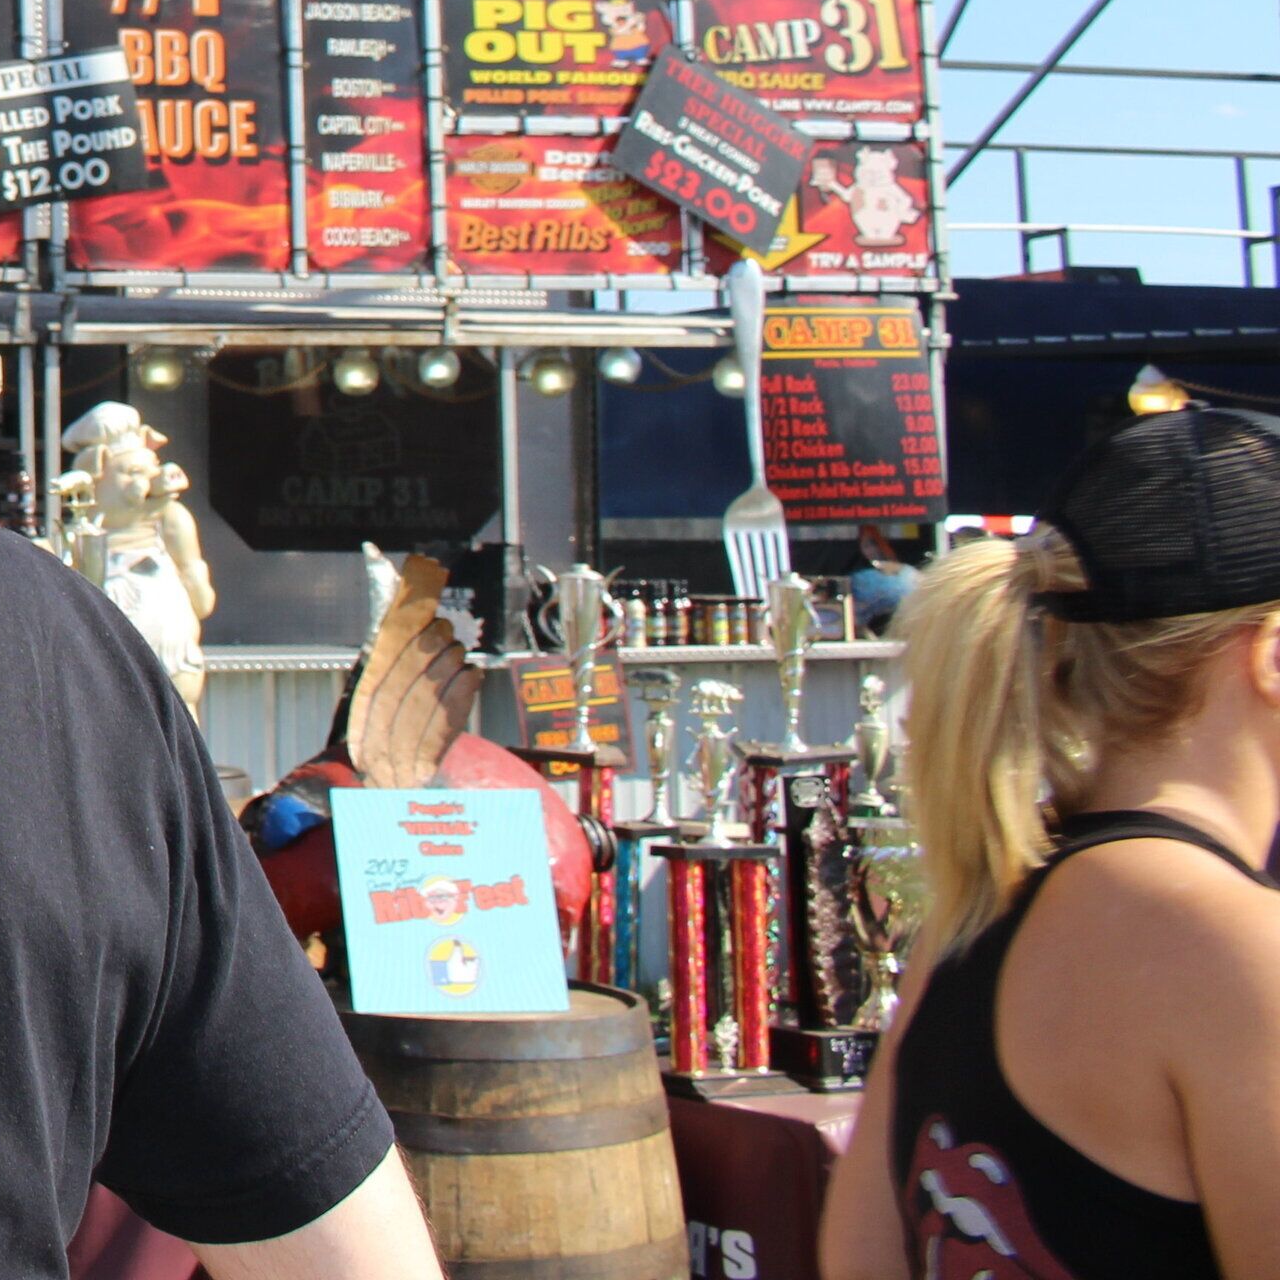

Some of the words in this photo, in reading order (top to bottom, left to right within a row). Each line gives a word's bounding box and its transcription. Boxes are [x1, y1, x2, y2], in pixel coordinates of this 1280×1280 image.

[464, 30, 606, 64] OUT
[703, 18, 822, 66] CAMP
[118, 28, 227, 93] BBQ
[470, 70, 552, 85] WORLD
[760, 72, 826, 92] SAUCE
[135, 99, 258, 158] AUCE
[683, 96, 768, 162] SPECIAL
[2, 157, 111, 203] $12.00
[322, 152, 397, 172] NAPERVILLE
[644, 150, 757, 234] $23.00
[458, 217, 531, 252] Best
[541, 218, 609, 253] Ribs
[763, 316, 874, 349] CAMP
[877, 316, 919, 349] 31
[283, 475, 386, 507] CAMP
[393, 476, 432, 508] 31
